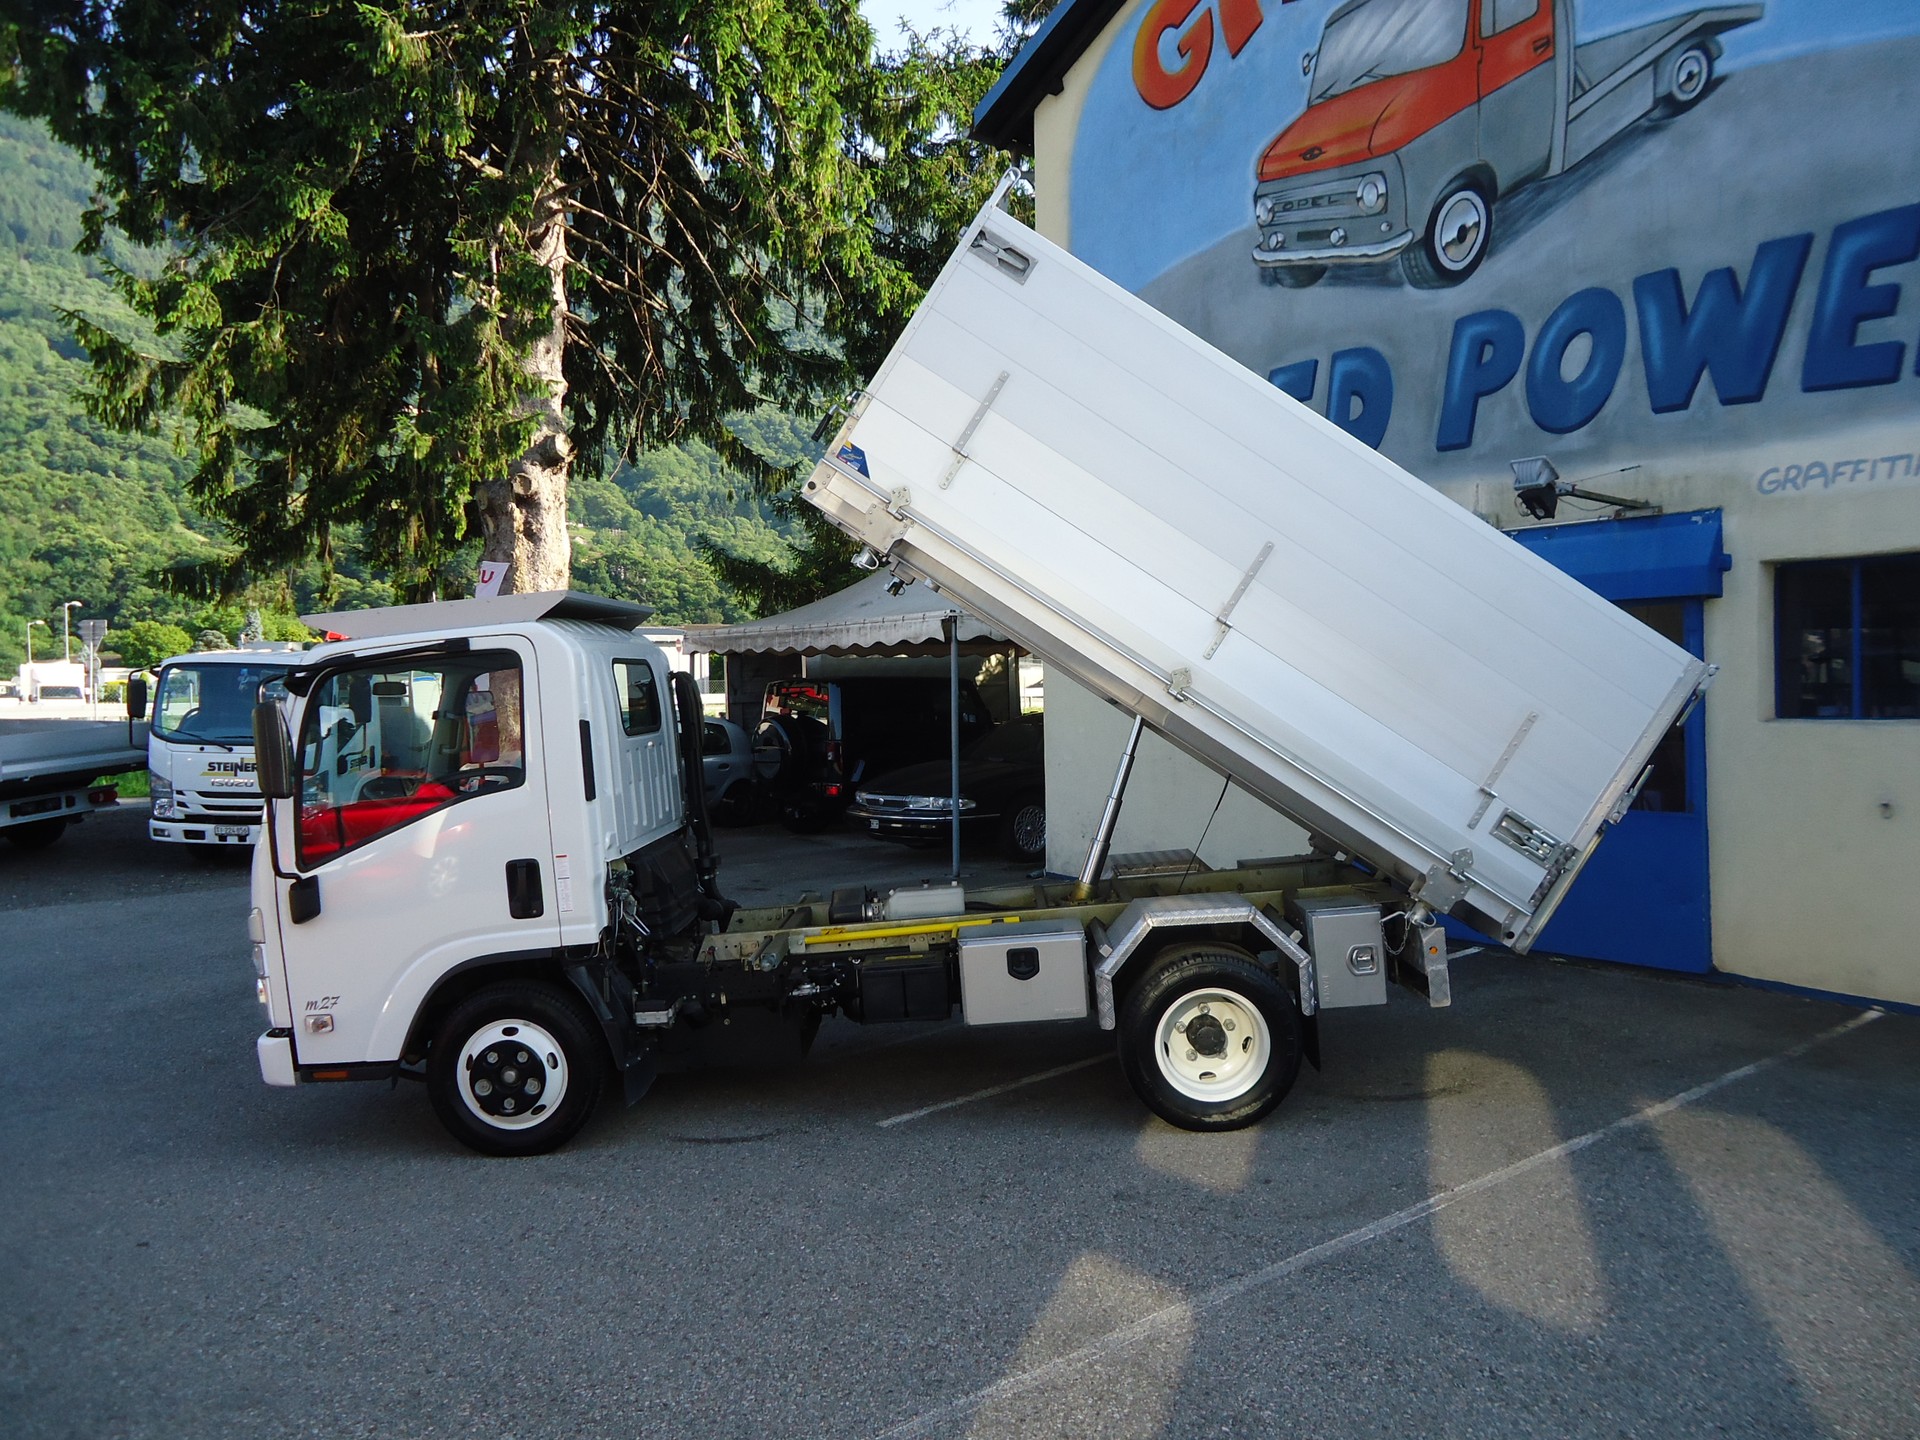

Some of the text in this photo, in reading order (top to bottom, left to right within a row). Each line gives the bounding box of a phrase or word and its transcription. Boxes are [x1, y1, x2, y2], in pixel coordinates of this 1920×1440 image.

[1282, 196, 1342, 211] OPEL
[1436, 202, 1920, 452] POWE
[211, 779, 255, 788] ISUZU
